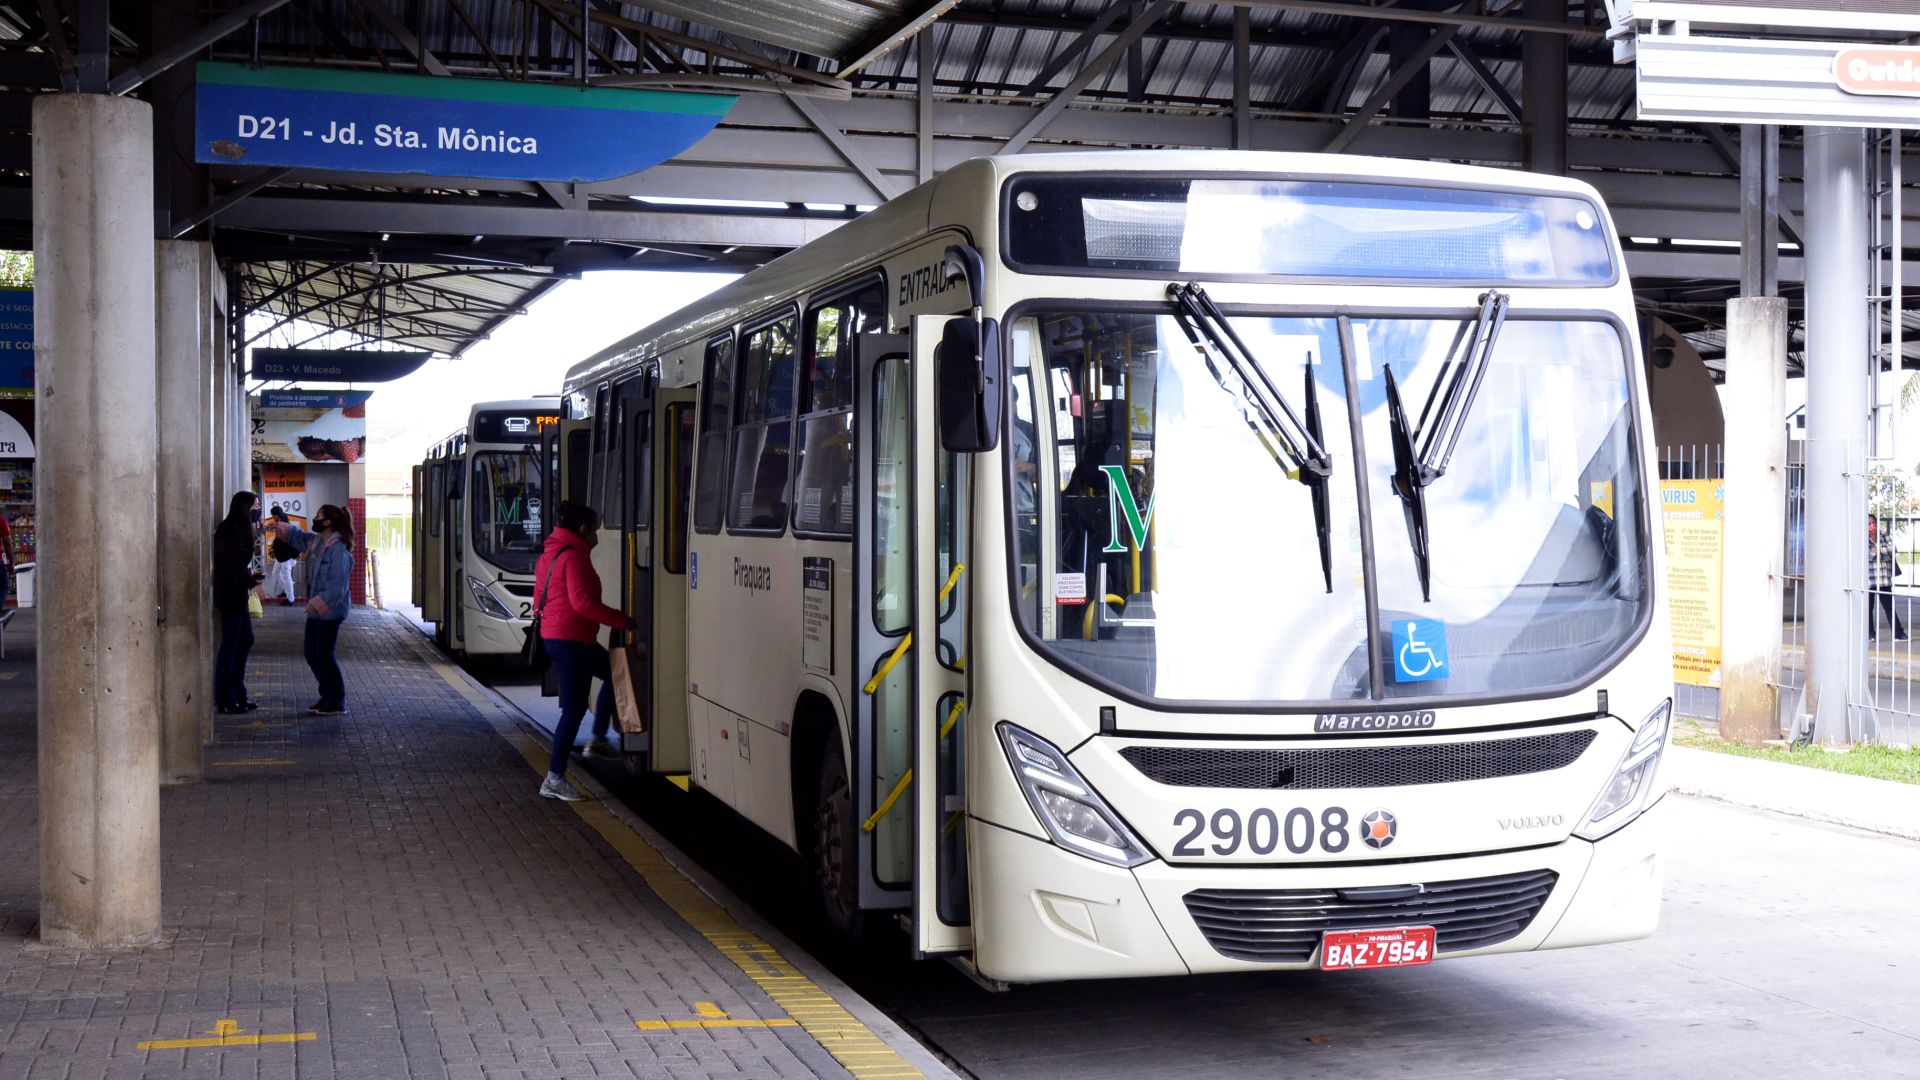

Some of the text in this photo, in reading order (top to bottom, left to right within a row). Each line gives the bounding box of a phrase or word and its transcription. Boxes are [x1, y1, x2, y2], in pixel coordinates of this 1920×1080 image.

[238, 114, 290, 140] D21
[320, 121, 364, 145] Jd.
[374, 123, 427, 149] Sta.
[438, 126, 538, 155] Mônica
[264, 364, 284, 373] D23
[303, 364, 342, 375] Macedo
[1662, 485, 1697, 504] VÍRUS
[734, 557, 771, 597] Piraquara
[1172, 806, 1350, 857] 29008
[1496, 814, 1564, 831] VOLVO
